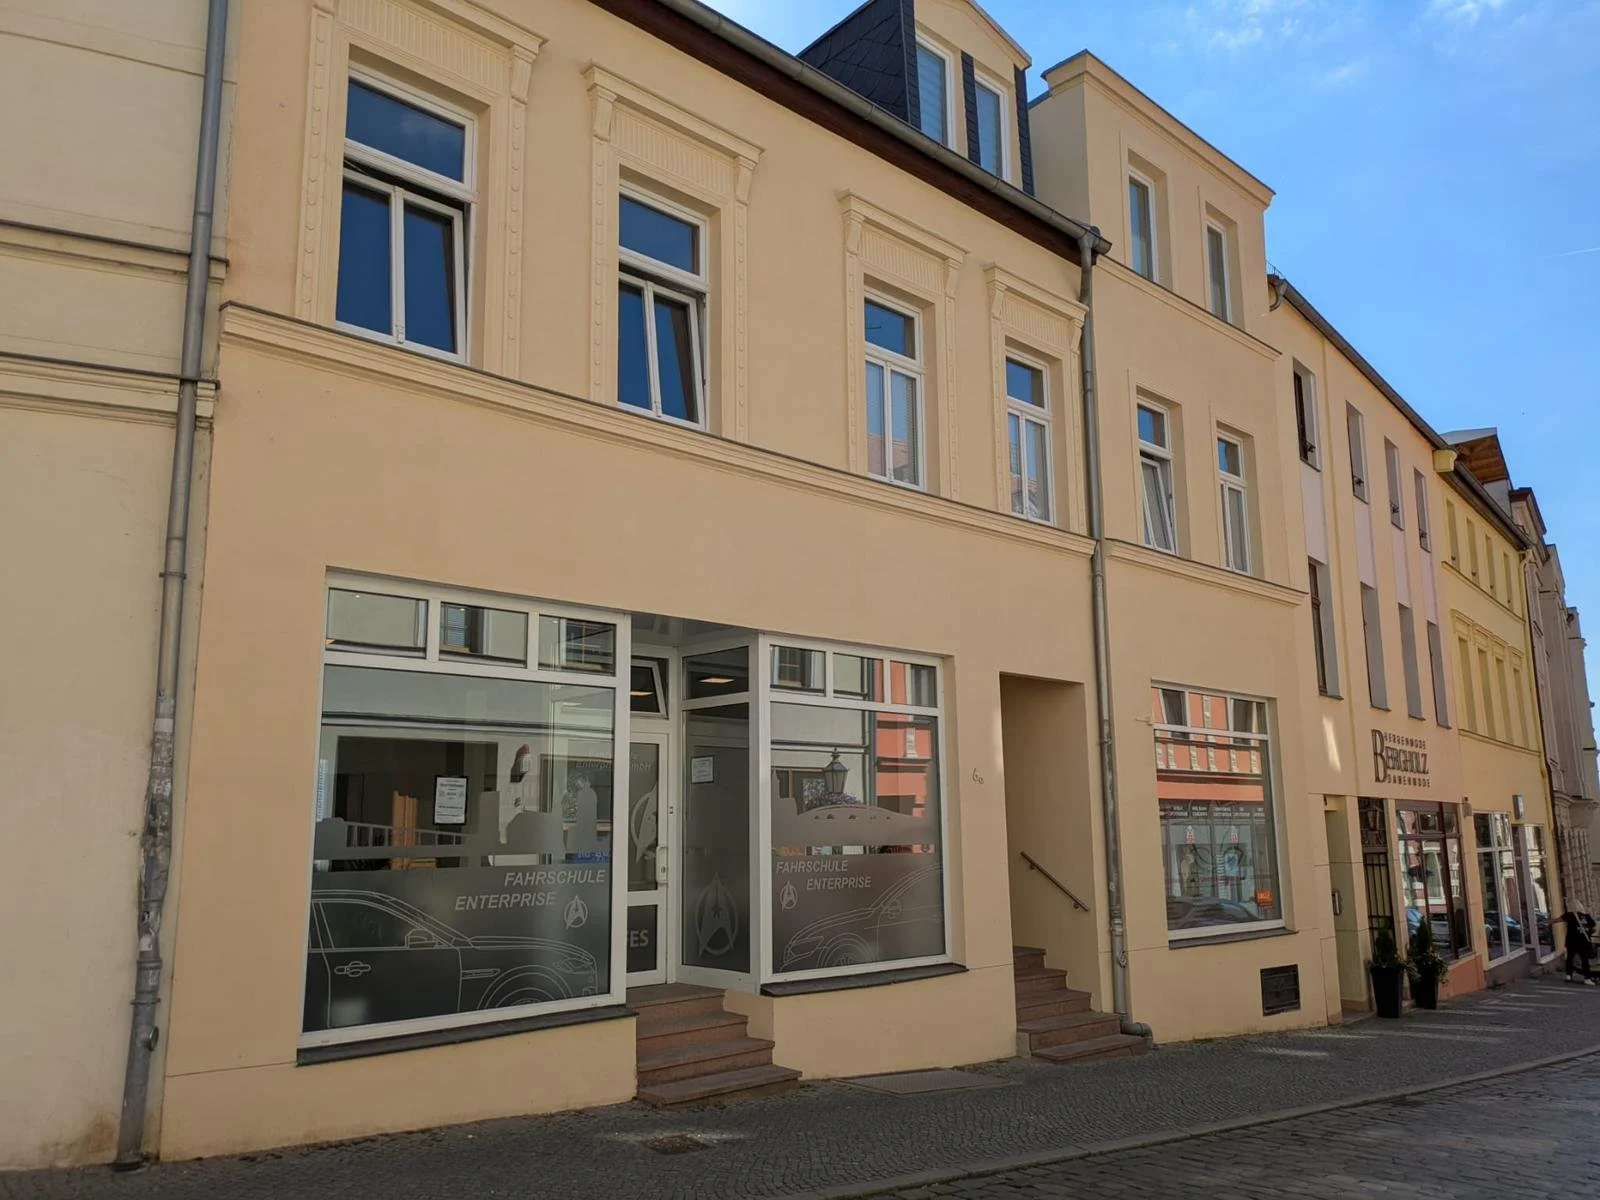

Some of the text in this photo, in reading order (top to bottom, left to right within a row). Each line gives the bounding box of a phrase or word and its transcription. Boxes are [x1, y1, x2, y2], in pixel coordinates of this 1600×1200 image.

[776, 859, 849, 874] FAHRSCHULE
[504, 869, 606, 887] FAHRSCHULE
[806, 876, 872, 891] ENTERPRISE
[454, 891, 557, 911] ENTERPRISE
